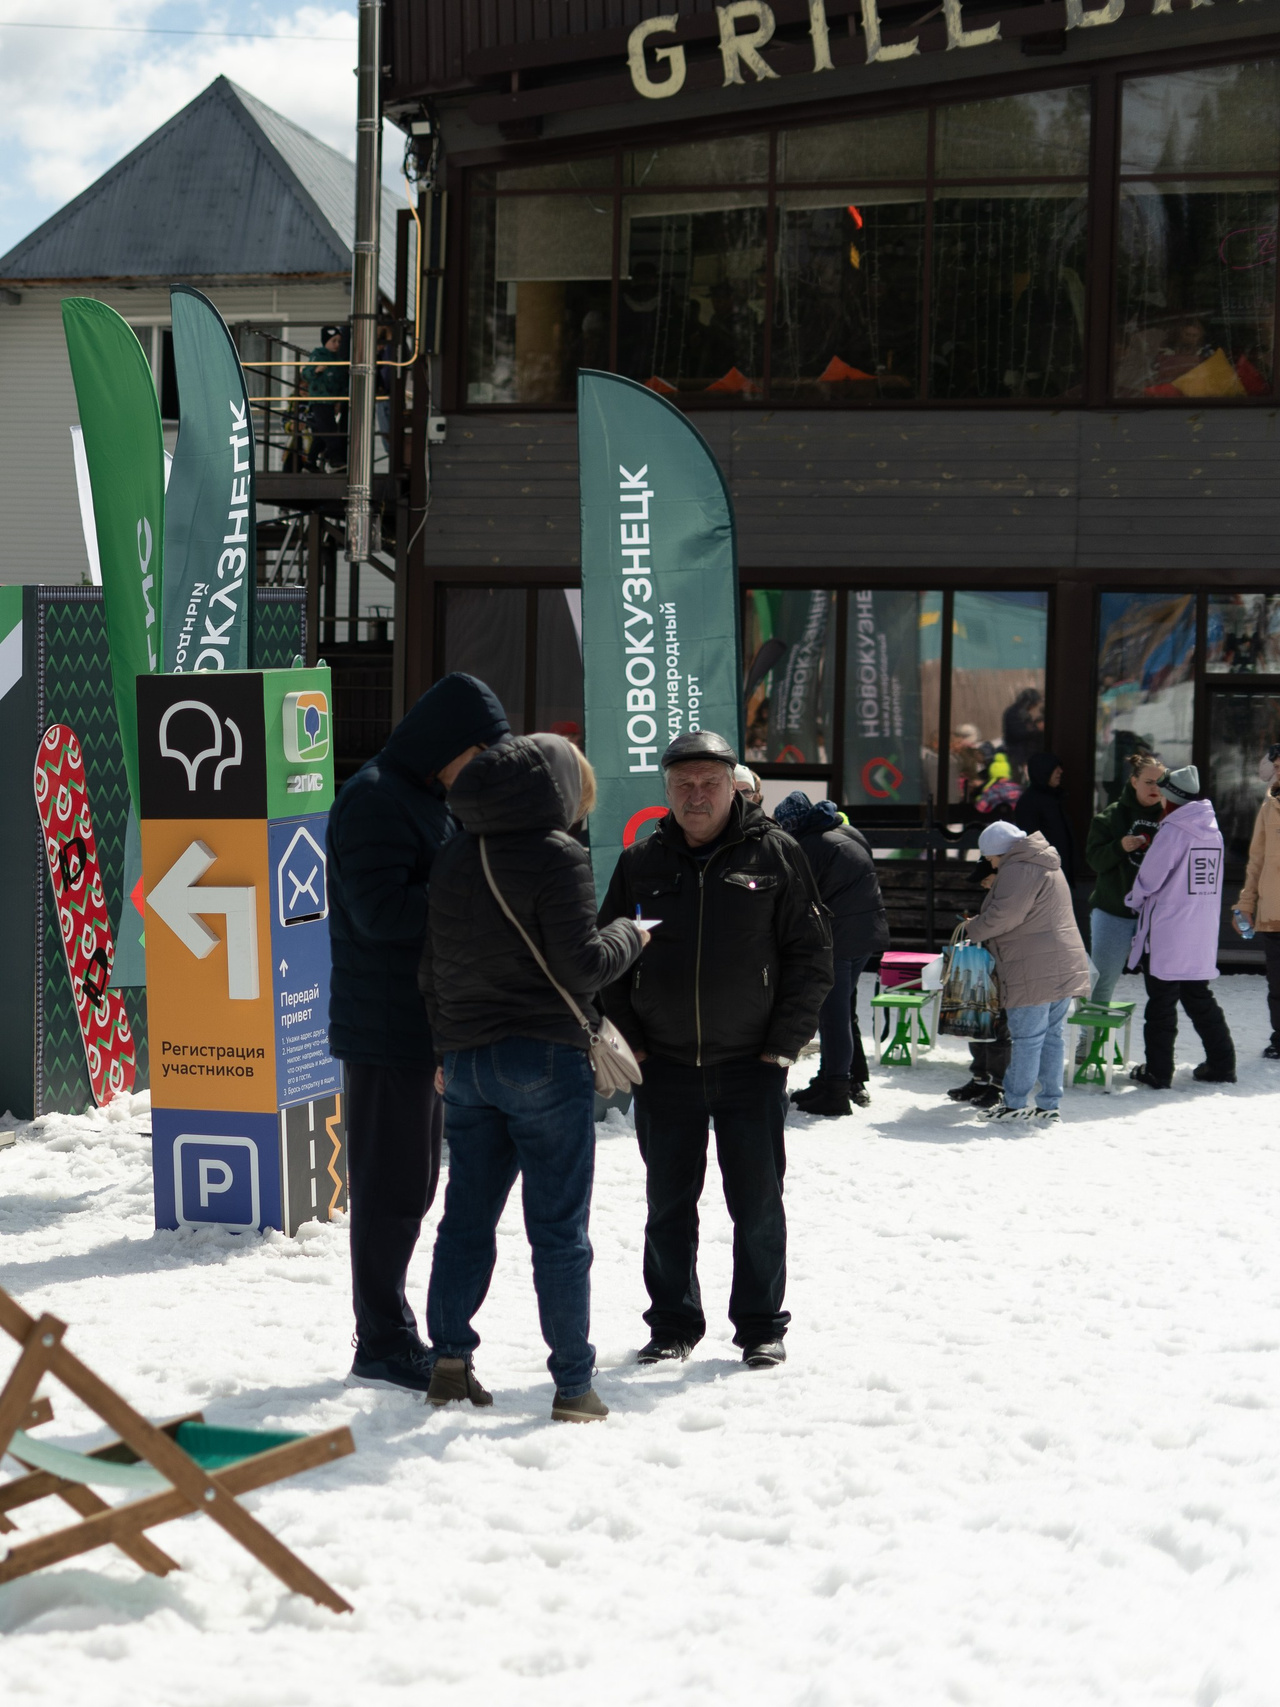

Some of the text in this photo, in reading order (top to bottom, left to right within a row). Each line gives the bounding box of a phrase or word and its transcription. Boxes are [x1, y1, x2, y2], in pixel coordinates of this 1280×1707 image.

[627, 0, 1001, 99] GRILL
[137, 516, 156, 672] ГИС
[619, 463, 659, 773] НОВОКУЗНЕЦК
[659, 602, 684, 745] ждународный
[856, 590, 880, 738] НОВОКУЗНЕ
[688, 674, 703, 734] опорт
[291, 773, 323, 793] 2ГИС
[280, 983, 320, 1008] Передай
[281, 1008, 312, 1028] привет
[286, 1034, 300, 1044] Укажи
[300, 1030, 312, 1041] адрес
[287, 1043, 303, 1054] Напиши
[304, 1042, 312, 1051] ему
[312, 1036, 329, 1047] что-ниб
[161, 1041, 265, 1060] Регистрация
[162, 1062, 254, 1078] участников
[288, 1086, 300, 1096] Брось
[301, 1081, 320, 1091] открытку
[198, 1158, 234, 1208] P
